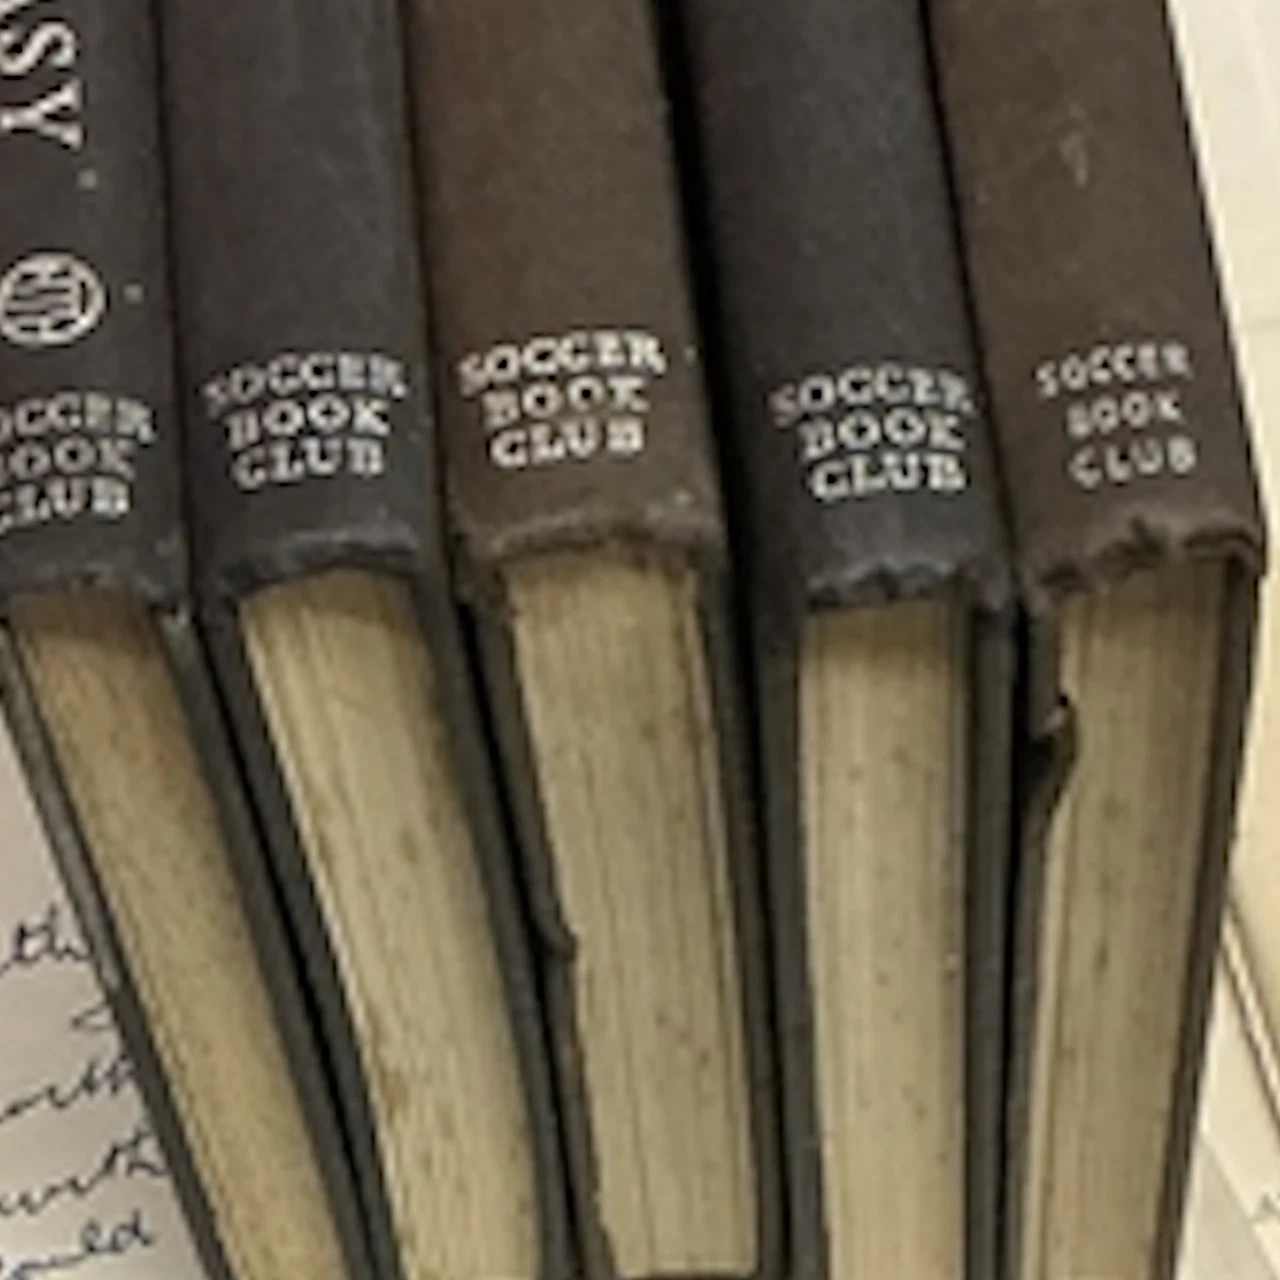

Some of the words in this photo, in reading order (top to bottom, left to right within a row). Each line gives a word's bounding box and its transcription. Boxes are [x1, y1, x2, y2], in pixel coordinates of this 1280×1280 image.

[203, 351, 410, 420] SOCCER
[457, 328, 668, 397] SOCCER
[1036, 342, 1192, 400] SOCCER
[222, 394, 391, 451] BOOK
[481, 376, 649, 428] BOOK
[769, 361, 976, 429] SOCCER
[1065, 390, 1182, 440] BOOK
[489, 415, 646, 470] CLUB
[798, 408, 966, 463] BOOK
[231, 438, 387, 491] CLUB
[809, 454, 968, 504] CLUB
[1068, 436, 1197, 491] CLUB
